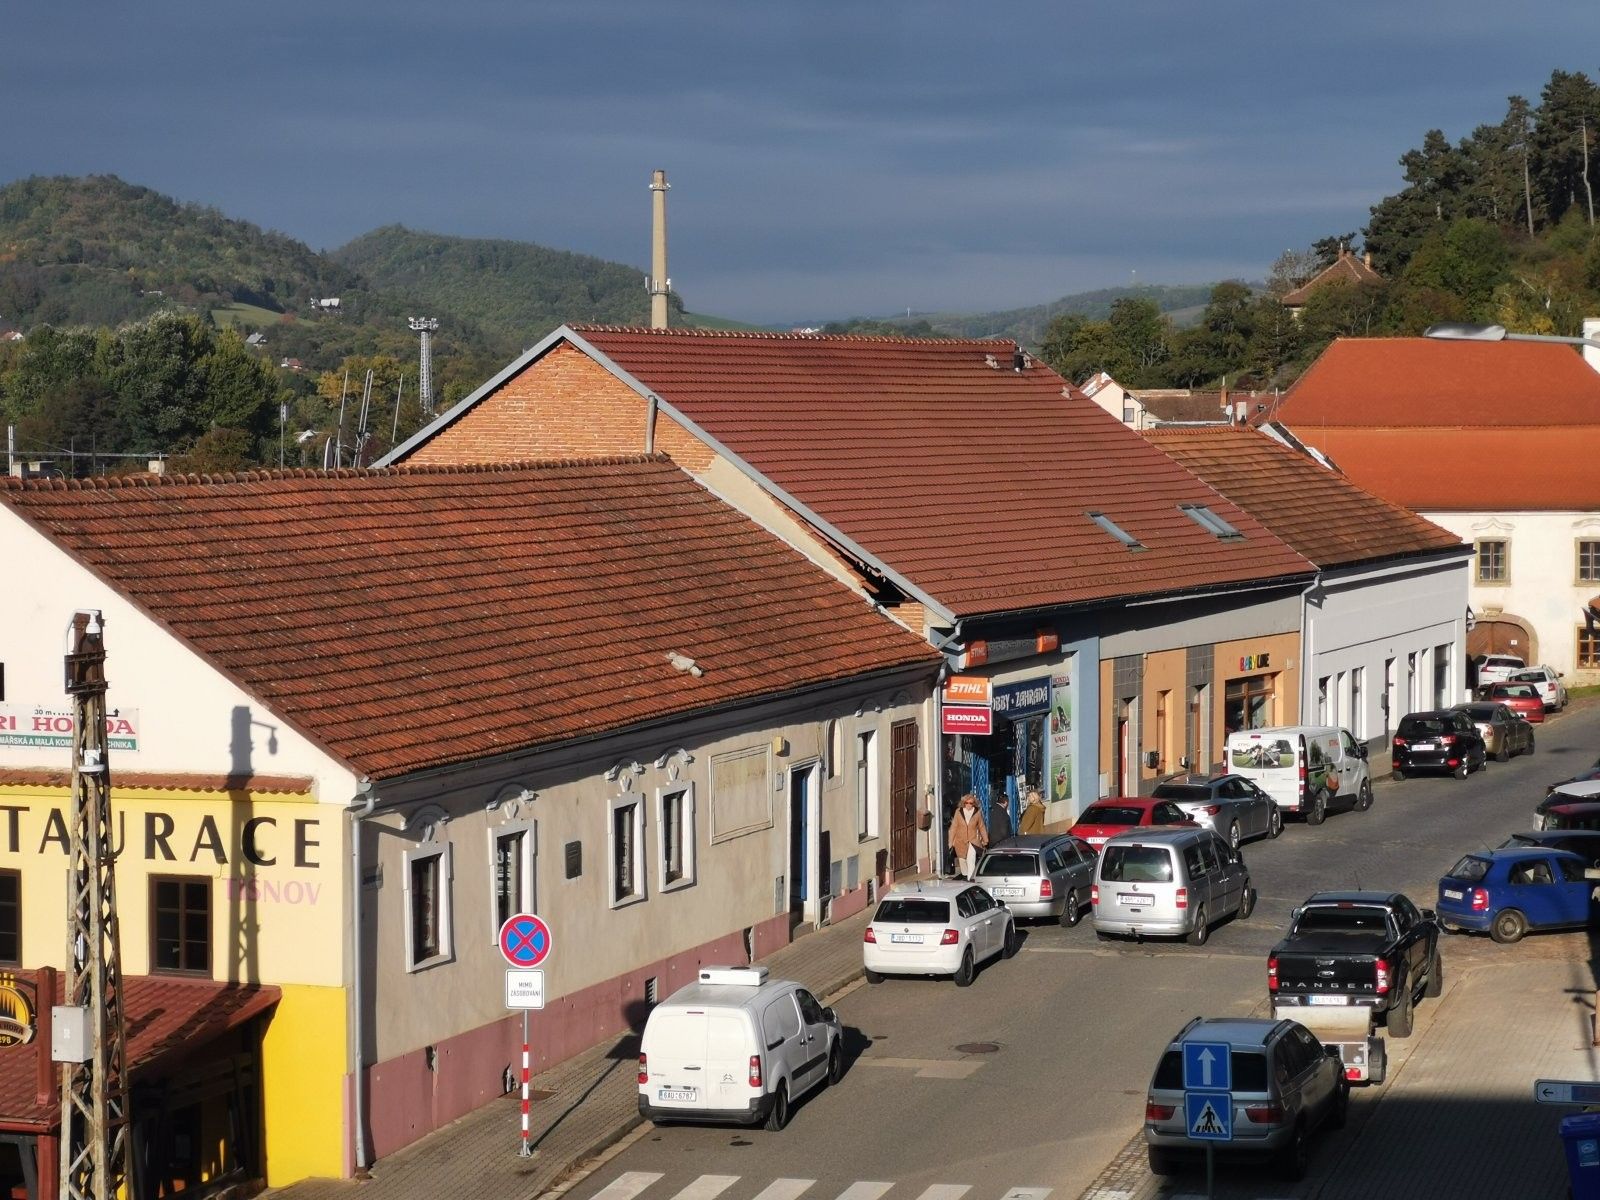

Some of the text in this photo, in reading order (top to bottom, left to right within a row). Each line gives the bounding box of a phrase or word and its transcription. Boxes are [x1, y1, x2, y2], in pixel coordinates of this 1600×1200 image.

[970, 647, 986, 658] STIHL
[949, 682, 984, 694] STIHL
[946, 714, 987, 722] HONDA
[221, 873, 322, 906] TIŠNOV
[510, 989, 541, 997] ZÁSOBOVÁNÍ
